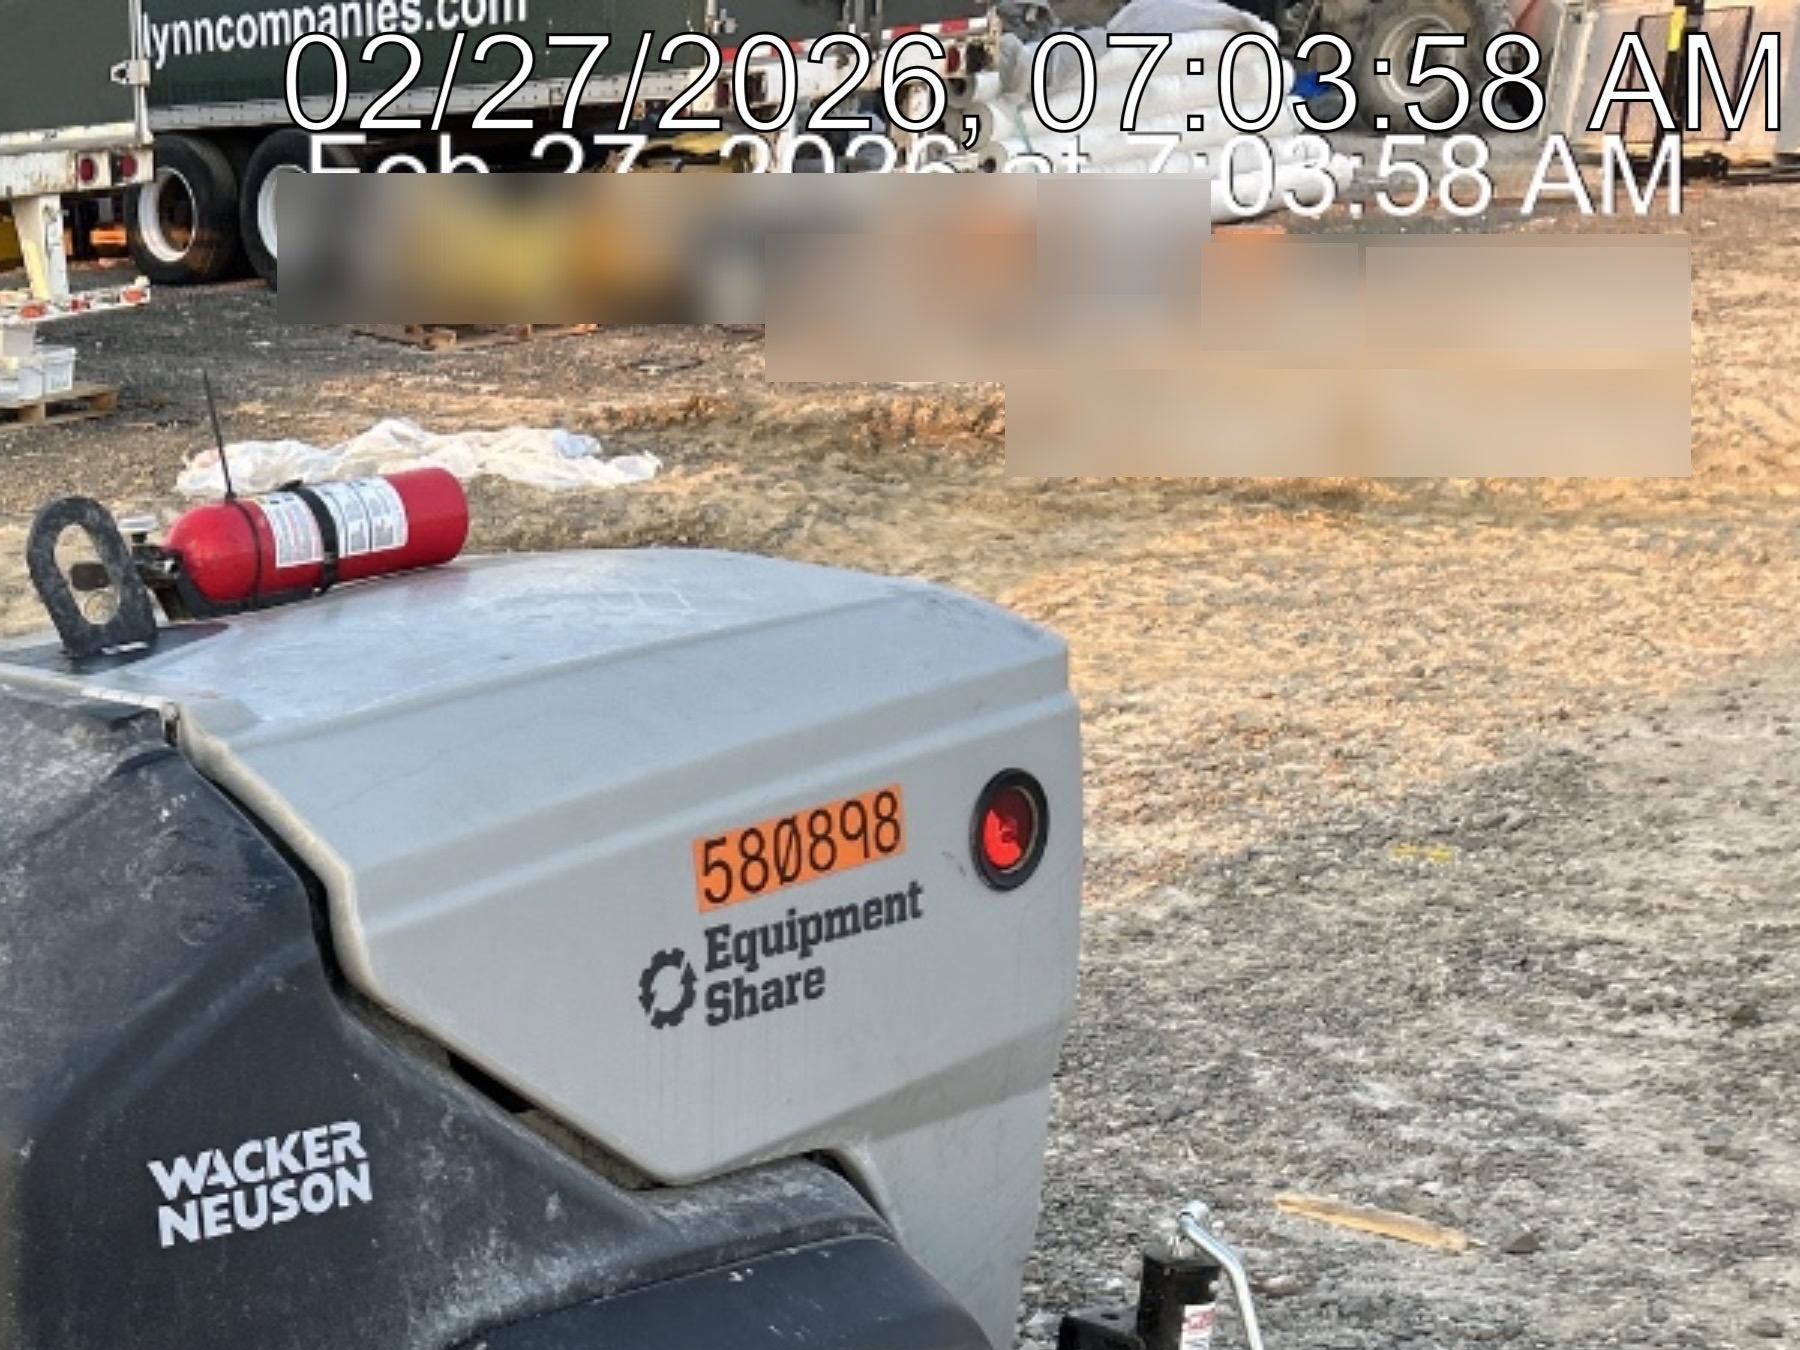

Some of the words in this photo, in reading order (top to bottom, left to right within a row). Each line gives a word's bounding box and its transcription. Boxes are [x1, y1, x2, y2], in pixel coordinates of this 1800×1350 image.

[143, 0, 527, 70] lynncompanies.com
[701, 790, 902, 905] 580898
[704, 880, 924, 973] Equipment
[705, 965, 826, 1028] Share
[147, 1120, 369, 1201] WACKER
[157, 1161, 374, 1249] NEUSON
